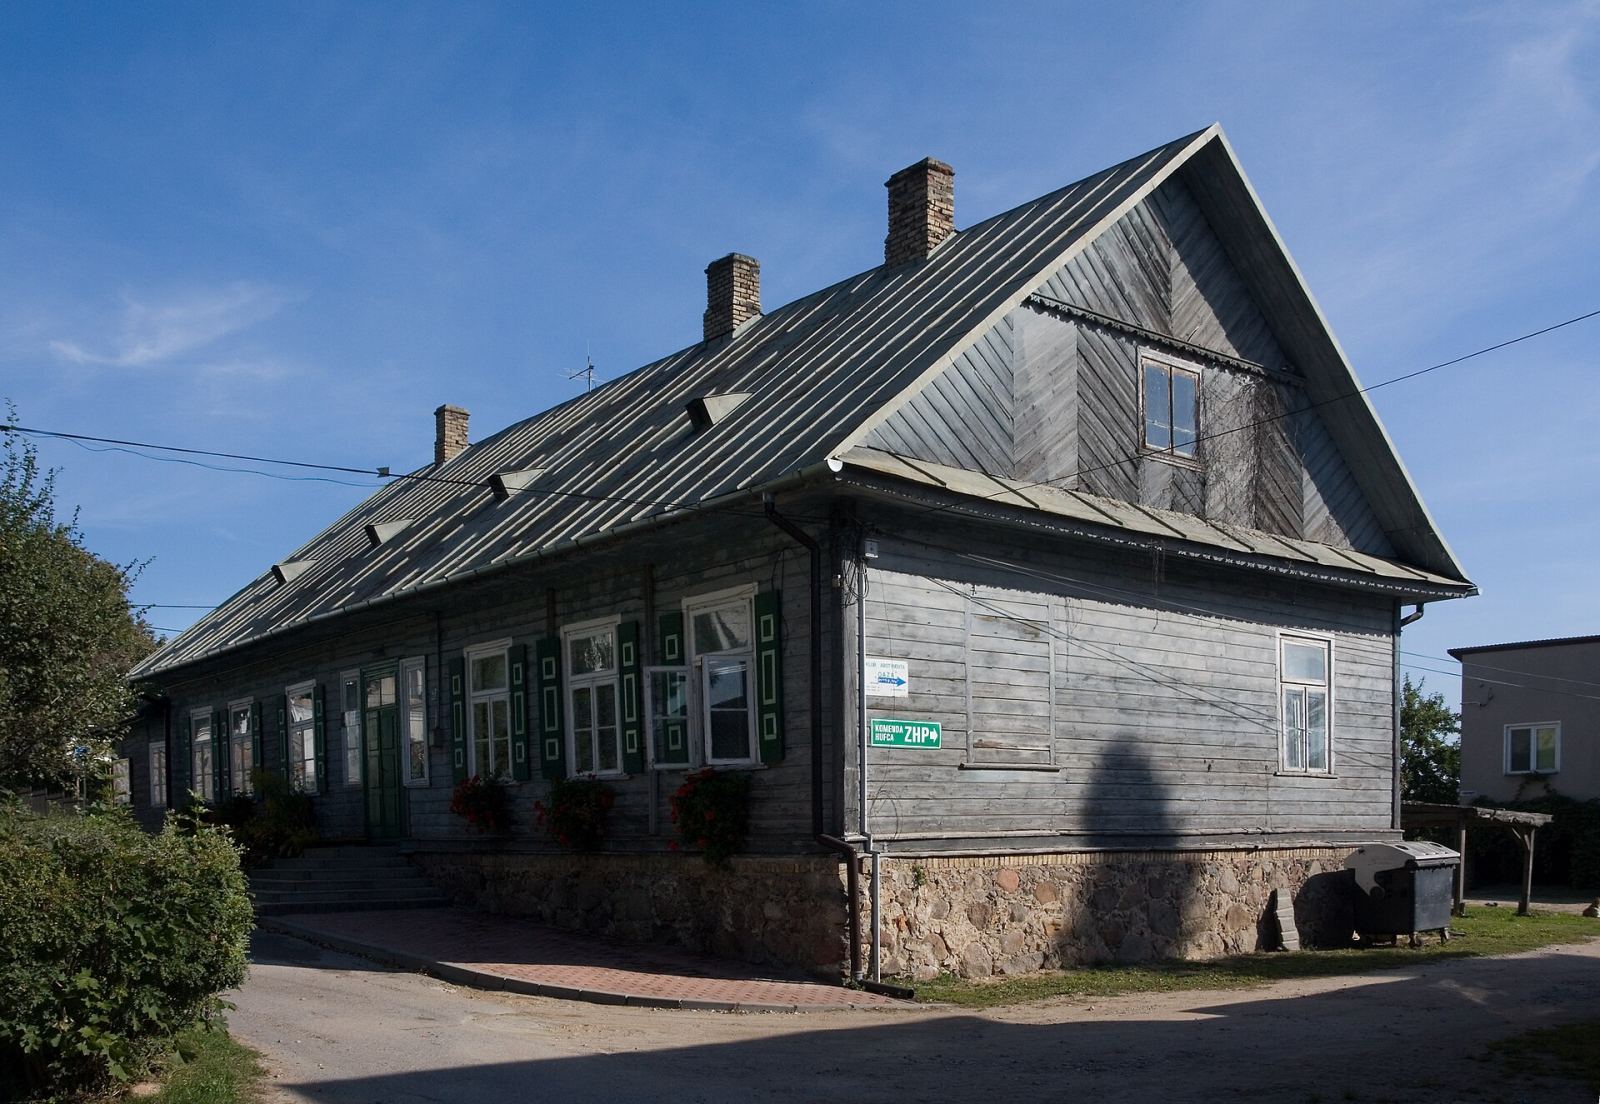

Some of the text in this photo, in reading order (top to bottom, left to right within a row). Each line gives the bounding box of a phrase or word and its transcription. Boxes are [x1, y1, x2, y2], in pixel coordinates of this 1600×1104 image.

[875, 724, 903, 734] KOMENDA
[875, 732, 894, 741] HUFCA
[904, 726, 930, 743] ZHP
